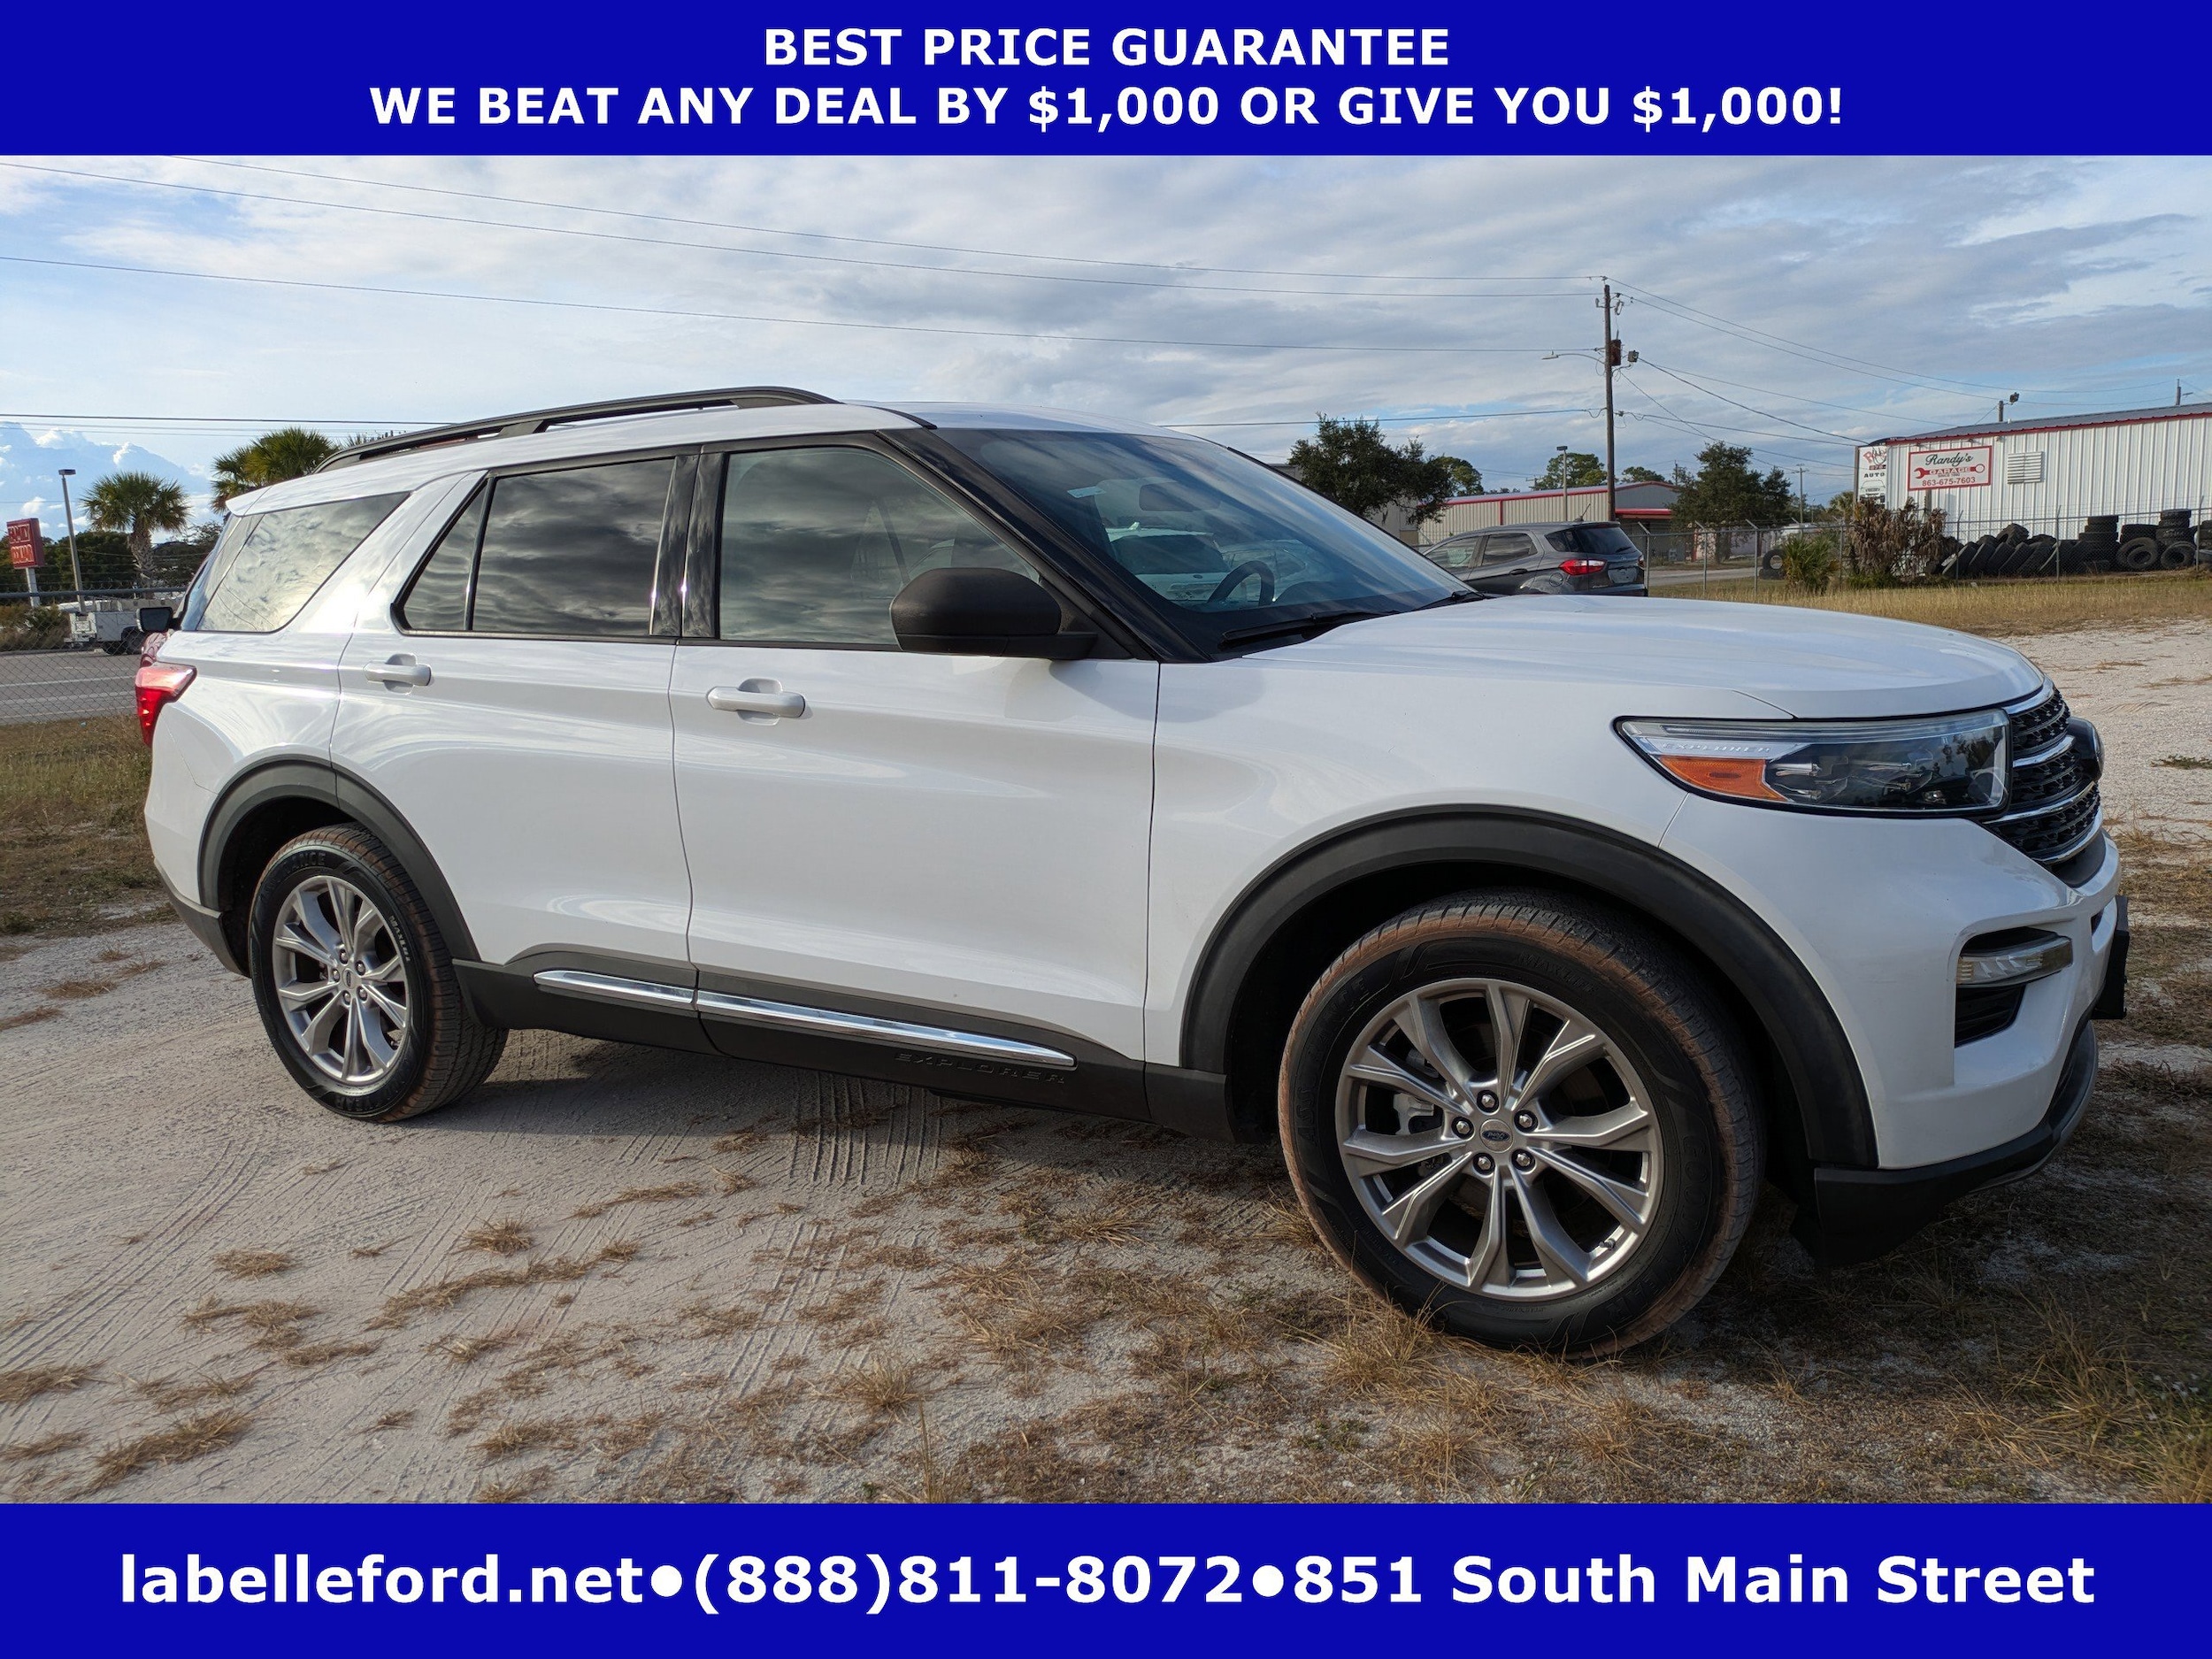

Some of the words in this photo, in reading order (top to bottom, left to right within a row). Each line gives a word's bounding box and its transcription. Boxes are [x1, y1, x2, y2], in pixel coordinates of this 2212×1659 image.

[1925, 452, 1973, 466] Randy's
[1922, 477, 1976, 487] 863-675-7603
[895, 1053, 1066, 1084] EXPLORER
